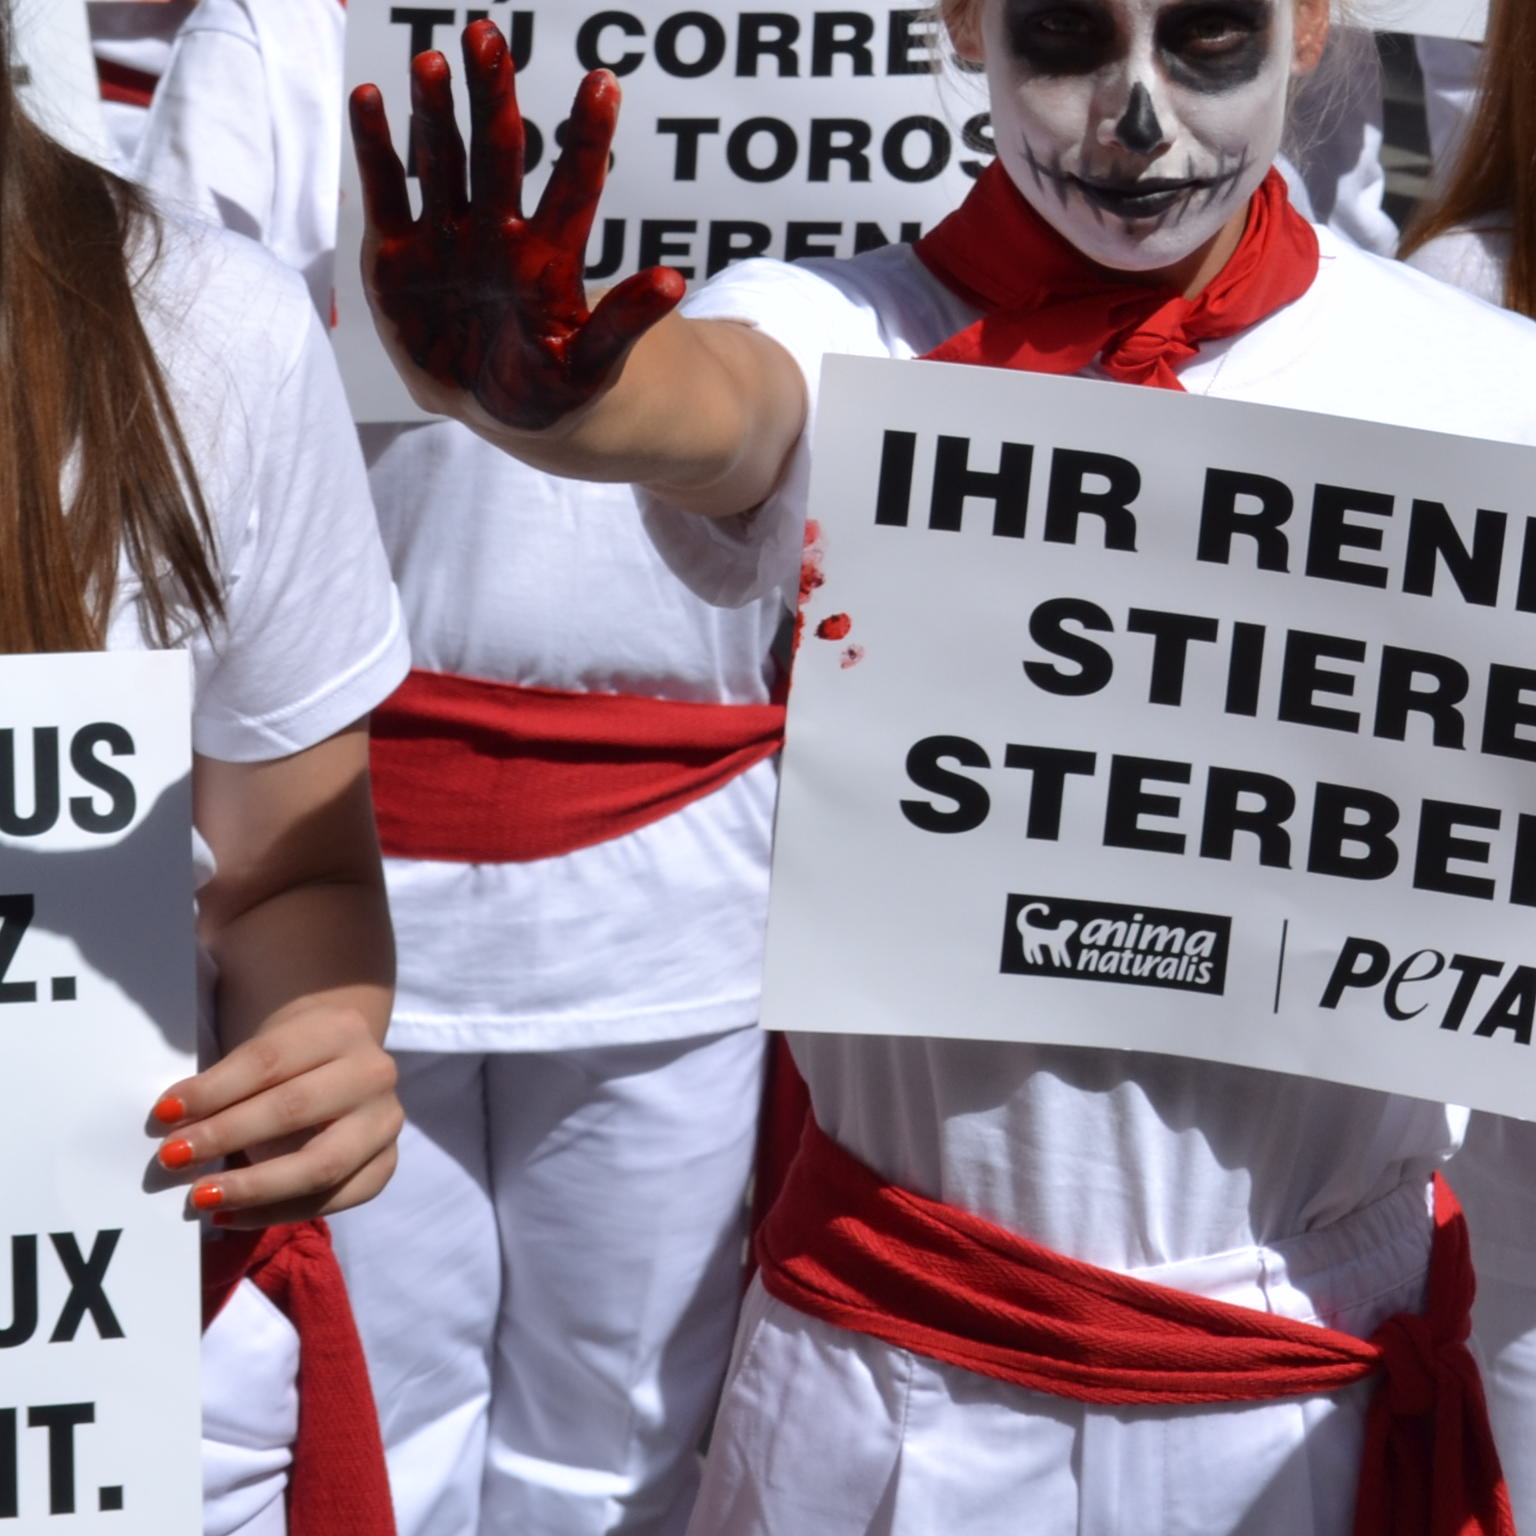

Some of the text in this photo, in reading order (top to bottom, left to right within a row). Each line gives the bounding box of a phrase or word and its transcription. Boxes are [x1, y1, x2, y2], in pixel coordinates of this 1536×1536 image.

[874, 427, 1144, 554] IHR
[1080, 910, 1218, 958] anima
[1076, 946, 1215, 988] naturalis
